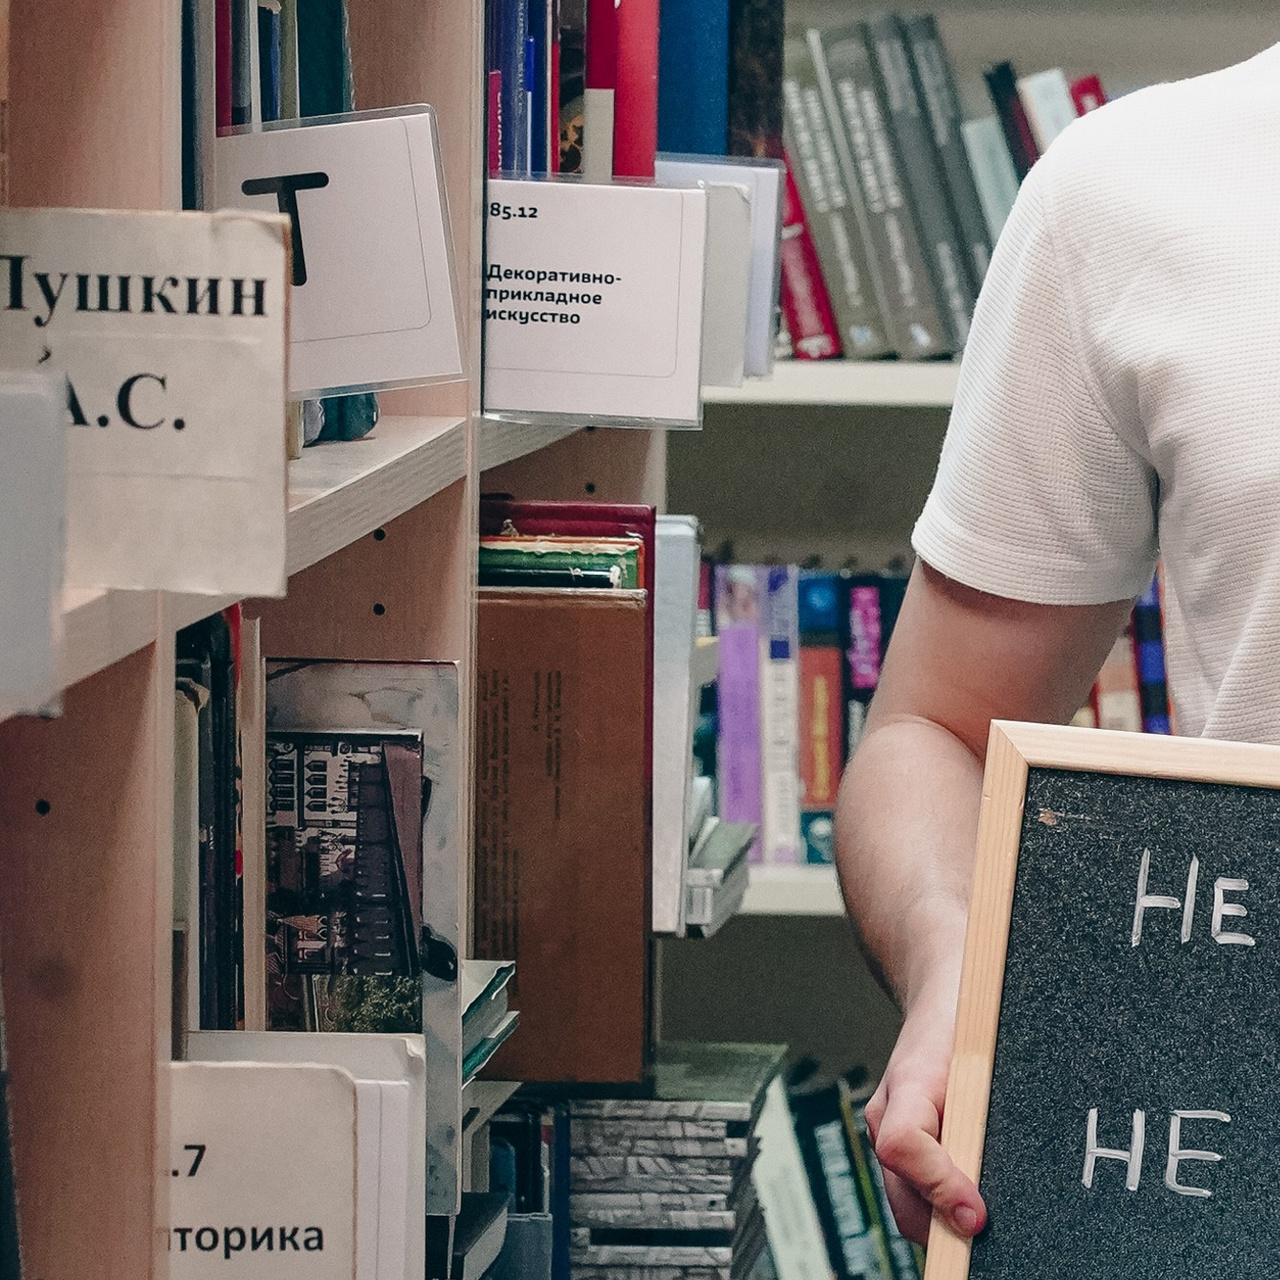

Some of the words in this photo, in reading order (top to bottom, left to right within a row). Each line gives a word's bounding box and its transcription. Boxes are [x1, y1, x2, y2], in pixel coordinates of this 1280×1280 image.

[490, 202, 538, 220] 85.12
[242, 171, 329, 287] Т
[487, 264, 622, 285] Декоративно-
[486, 288, 603, 305] прикладное
[486, 309, 581, 325] искусство
[1131, 848, 1256, 948] НЕ
[166, 1144, 206, 1177] .7
[1081, 1108, 1231, 1197] НЕ
[168, 1226, 324, 1259] торика
